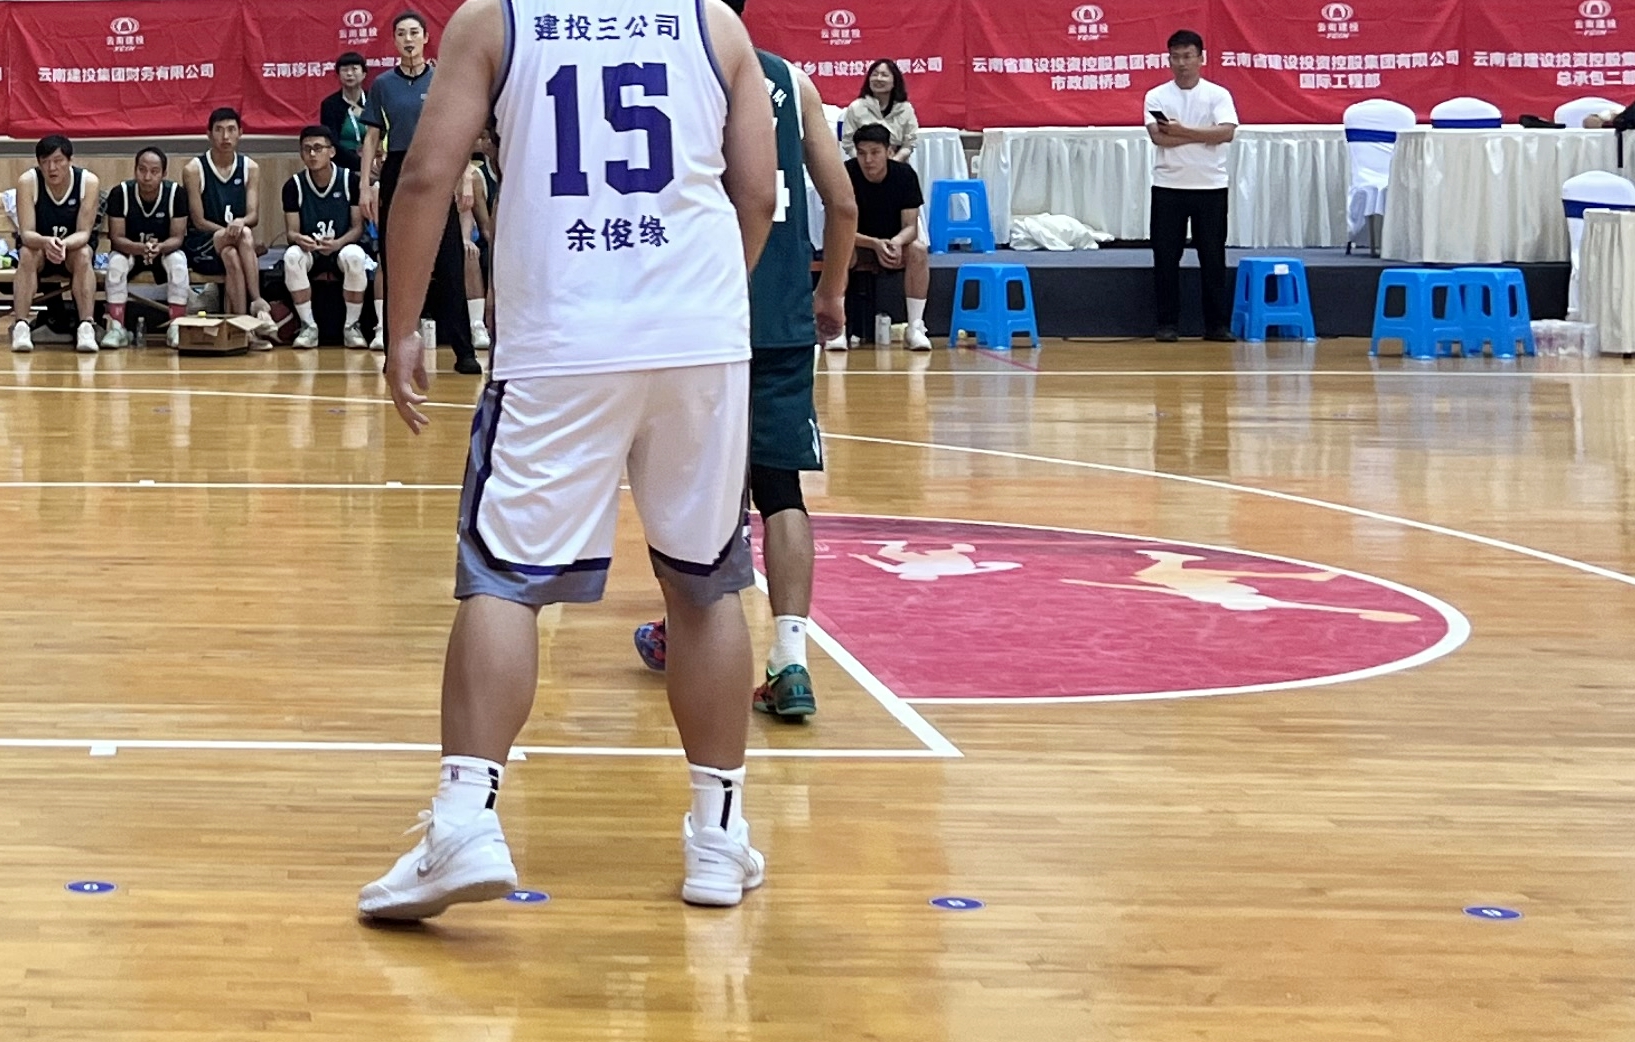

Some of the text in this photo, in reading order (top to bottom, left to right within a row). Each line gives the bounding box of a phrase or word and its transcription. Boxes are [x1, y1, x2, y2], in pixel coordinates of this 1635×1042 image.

[534, 14, 681, 42] 建投三公司
[38, 63, 214, 83] 云南建投集团财务有限公司
[1221, 50, 1459, 71] 云南省建设投资控股集团有限公司
[545, 62, 675, 198] 15
[565, 215, 670, 252] 余俊缘
